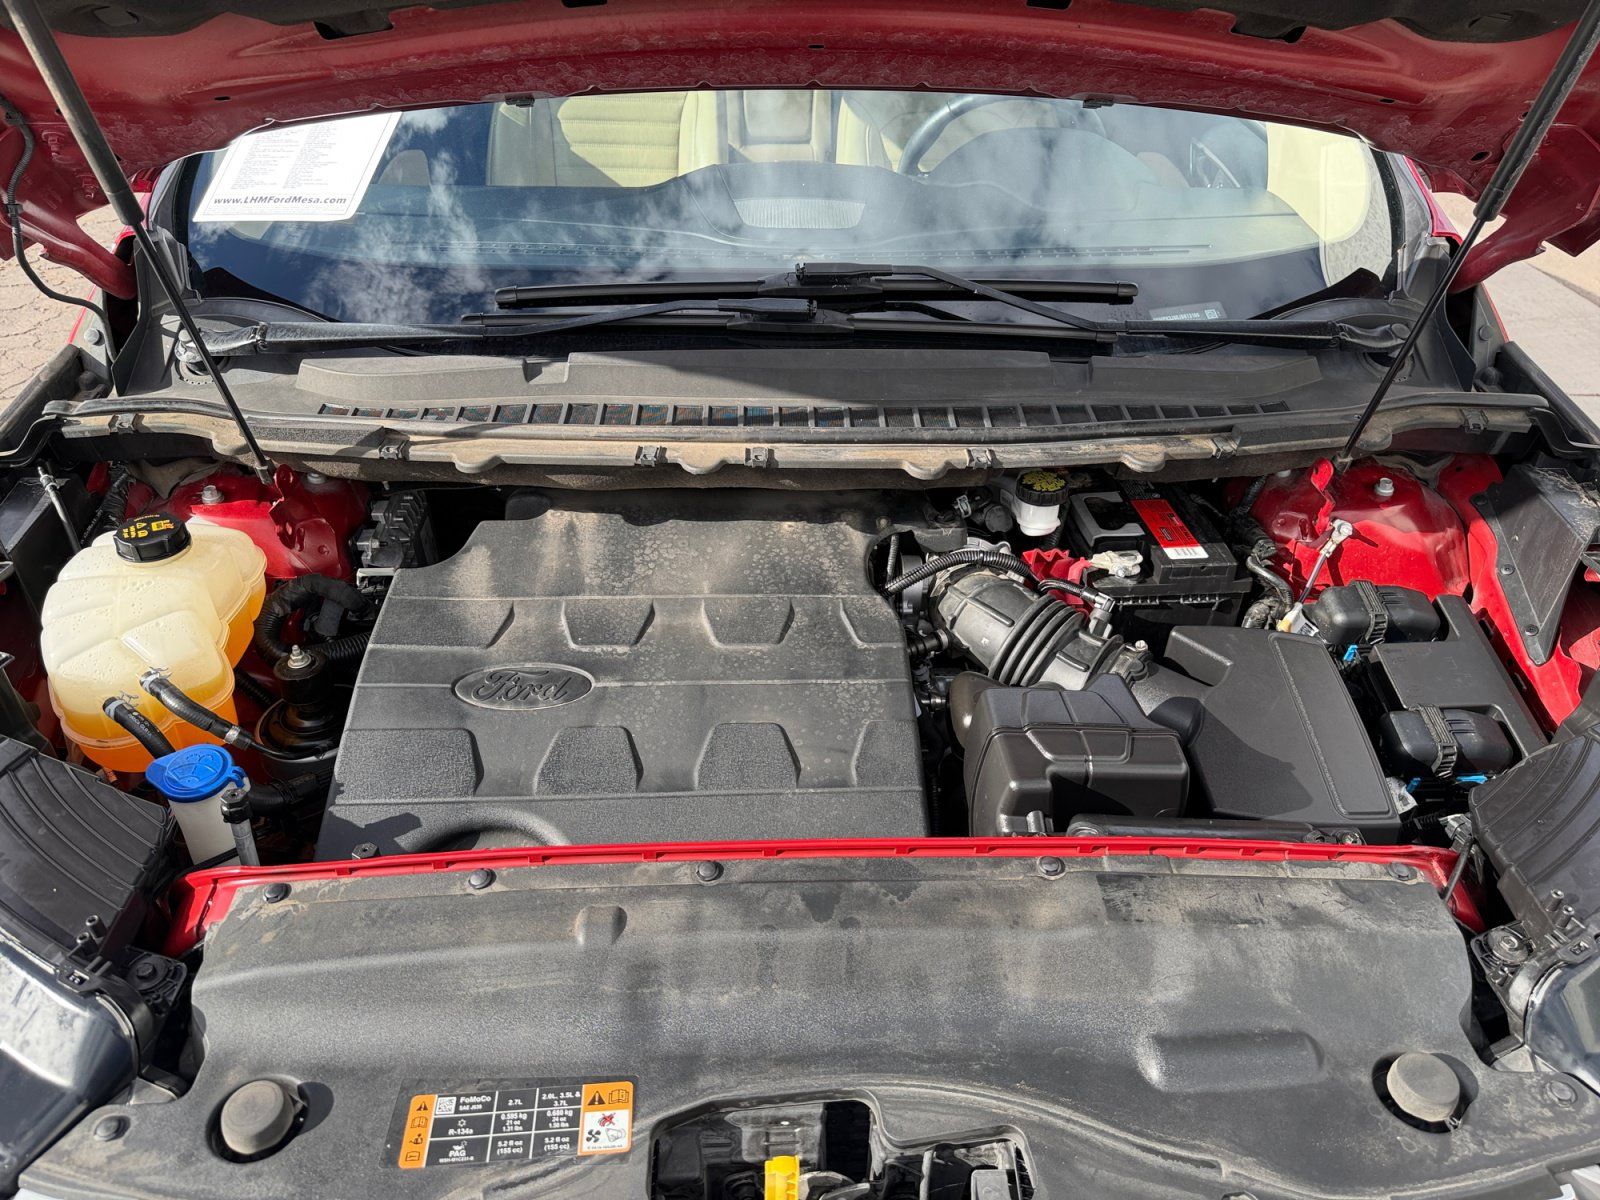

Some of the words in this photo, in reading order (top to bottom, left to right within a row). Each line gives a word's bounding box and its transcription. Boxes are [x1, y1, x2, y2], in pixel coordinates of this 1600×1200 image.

[213, 195, 347, 204] www.LHMFordMesa.com
[471, 670, 572, 702] Ford
[559, 1091, 574, 1099] 3.5L
[460, 1095, 491, 1104] FoMoCo
[508, 1098, 523, 1106] 2.7L
[518, 1112, 528, 1120] kg
[448, 1128, 474, 1136] R-134a
[496, 1148, 511, 1156] (155
